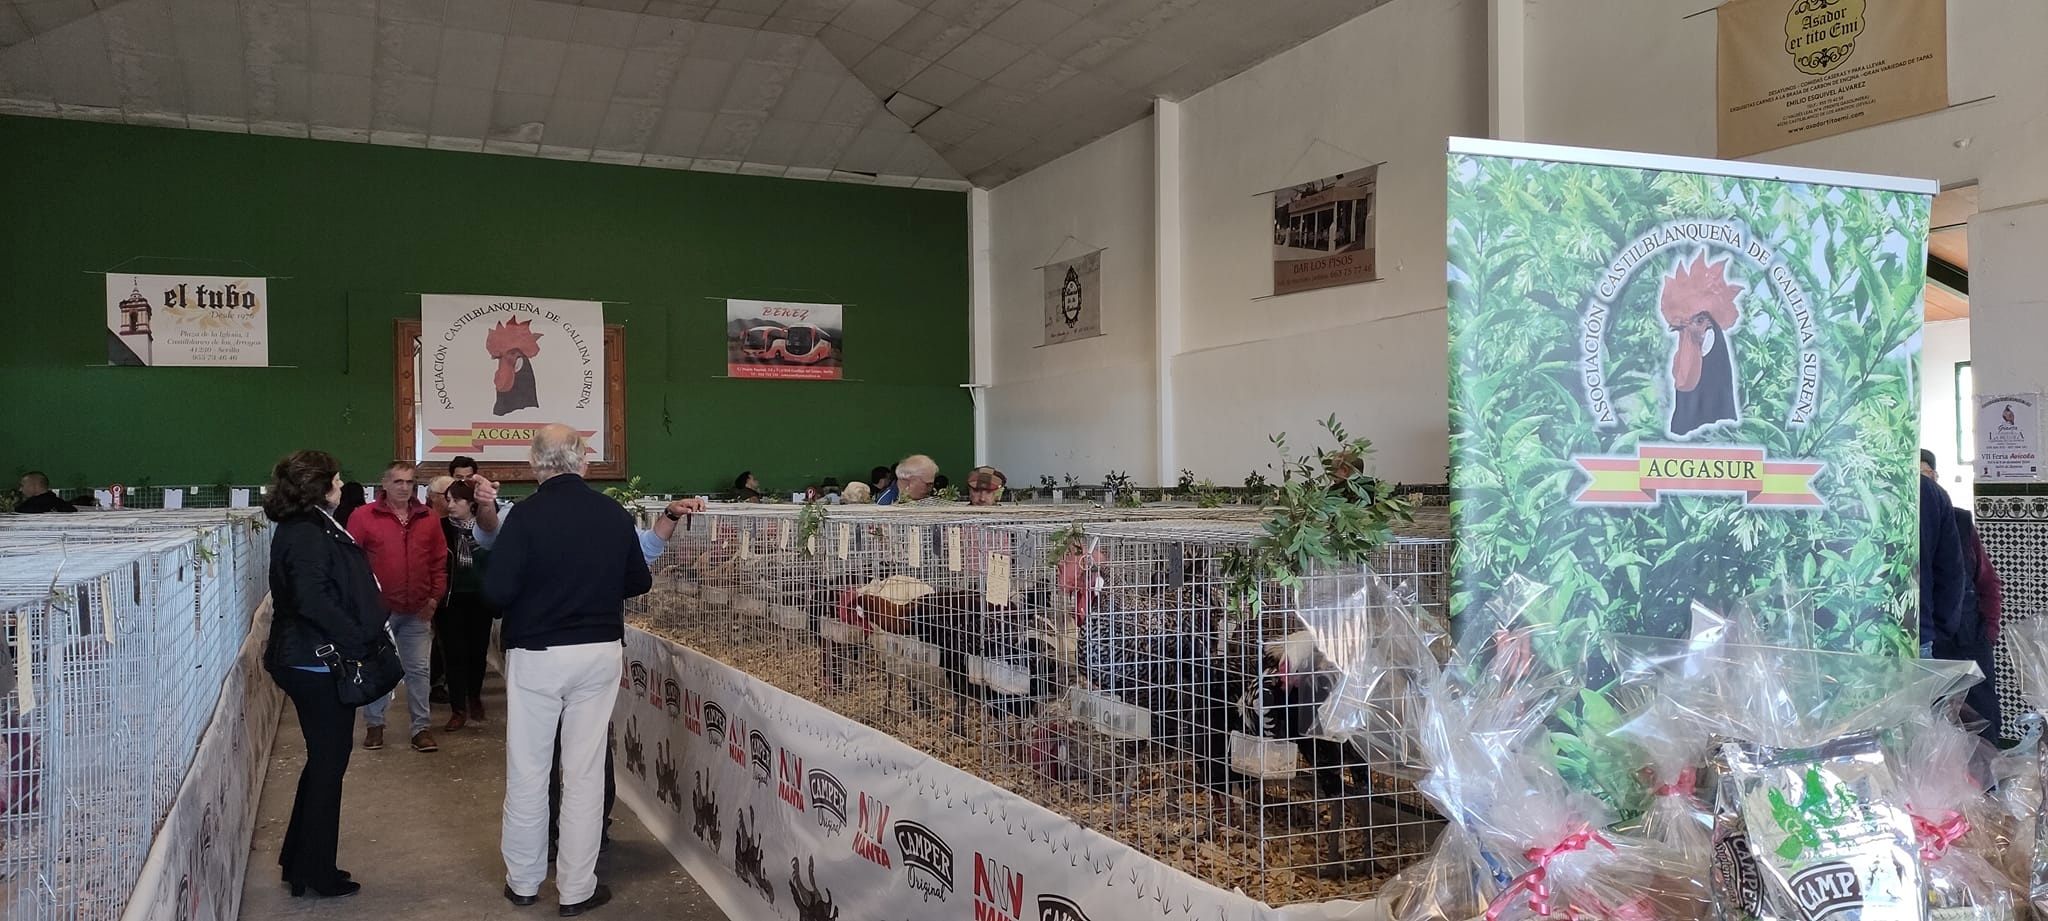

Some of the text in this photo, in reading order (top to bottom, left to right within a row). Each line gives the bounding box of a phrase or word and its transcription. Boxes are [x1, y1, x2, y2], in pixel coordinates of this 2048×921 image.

[1790, 17, 1858, 50] er tito Emi
[1802, 7, 1847, 31] Asador
[1769, 85, 1796, 96] DESAYUNOS
[1801, 77, 1823, 87] COMIDAS
[1824, 71, 1846, 81] CASERAS
[1867, 60, 1885, 69] LLEVAR
[1787, 89, 1802, 97] BRASA
[1881, 61, 1906, 71] VARIEDAD
[1917, 53, 1933, 62] TAPAS
[1787, 80, 1866, 107] EMILIO ESQUIVEL ÁLVAREZ
[1788, 111, 1864, 133] www.asadortitoemi.com
[1311, 260, 1326, 271] LOS
[164, 283, 255, 310] el tubo
[1584, 223, 1816, 425] ASOCIACIÓN CASTILBLANQUEÑA DE GALLINA SUREÑA
[433, 302, 593, 411] ASOCIACIÓN CASTILBLANQUEÑA DE GALLINA SUREÑA
[477, 429, 536, 440] ACGAS
[1648, 459, 1757, 479] ACGASUR
[778, 780, 805, 813] NANTA
[811, 777, 846, 817] CAMPER
[852, 831, 892, 870] NANTA
[898, 831, 952, 882] CAMPER
[907, 865, 946, 903] Original
[1732, 838, 1759, 913] CAMPER
[1798, 872, 1860, 910] CAMP
